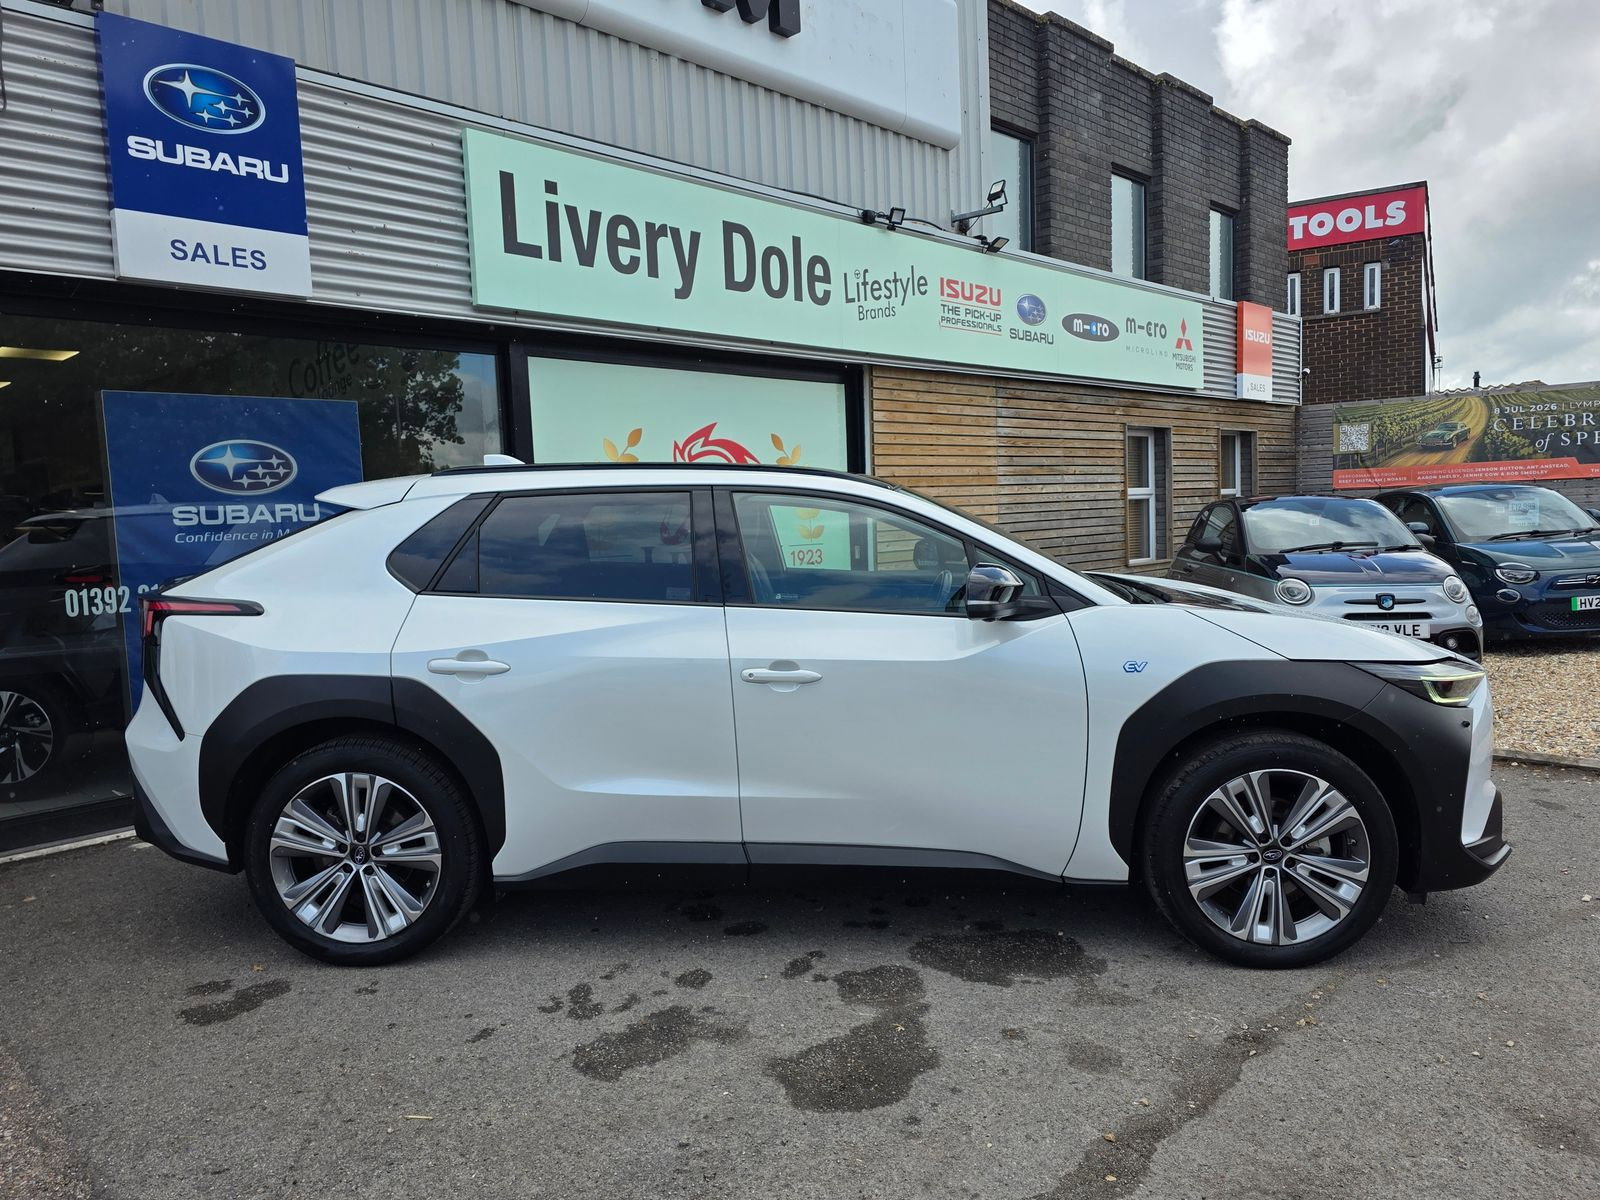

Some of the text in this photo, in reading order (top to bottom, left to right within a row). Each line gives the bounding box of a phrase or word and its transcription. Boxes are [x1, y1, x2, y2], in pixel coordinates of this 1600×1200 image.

[127, 135, 289, 184] SUBARU
[1289, 200, 1407, 240] TOOLS
[499, 169, 832, 306] Livery Dole
[170, 239, 267, 271] SALES
[843, 265, 928, 306] Lifestyle
[939, 277, 1002, 307] ISUZU
[858, 302, 897, 321] Brands
[940, 304, 1002, 323] THE PICK-UP
[940, 317, 1002, 332] PROFESSIONALS
[1009, 328, 1055, 345] SUBARU
[1245, 328, 1270, 345] ISUZU
[1175, 362, 1194, 371] MOTORS
[1250, 382, 1266, 393] SALES
[1504, 405, 1525, 414] JUL
[1529, 403, 1558, 412] 2026
[1493, 412, 1596, 432] CELEBR
[1535, 432, 1554, 453] of
[172, 503, 320, 526] SUBARU
[174, 531, 258, 544] Confidence
[262, 529, 274, 540] in
[789, 549, 823, 567] 1923
[65, 586, 131, 617] 01392
[1122, 660, 1148, 673] EV
